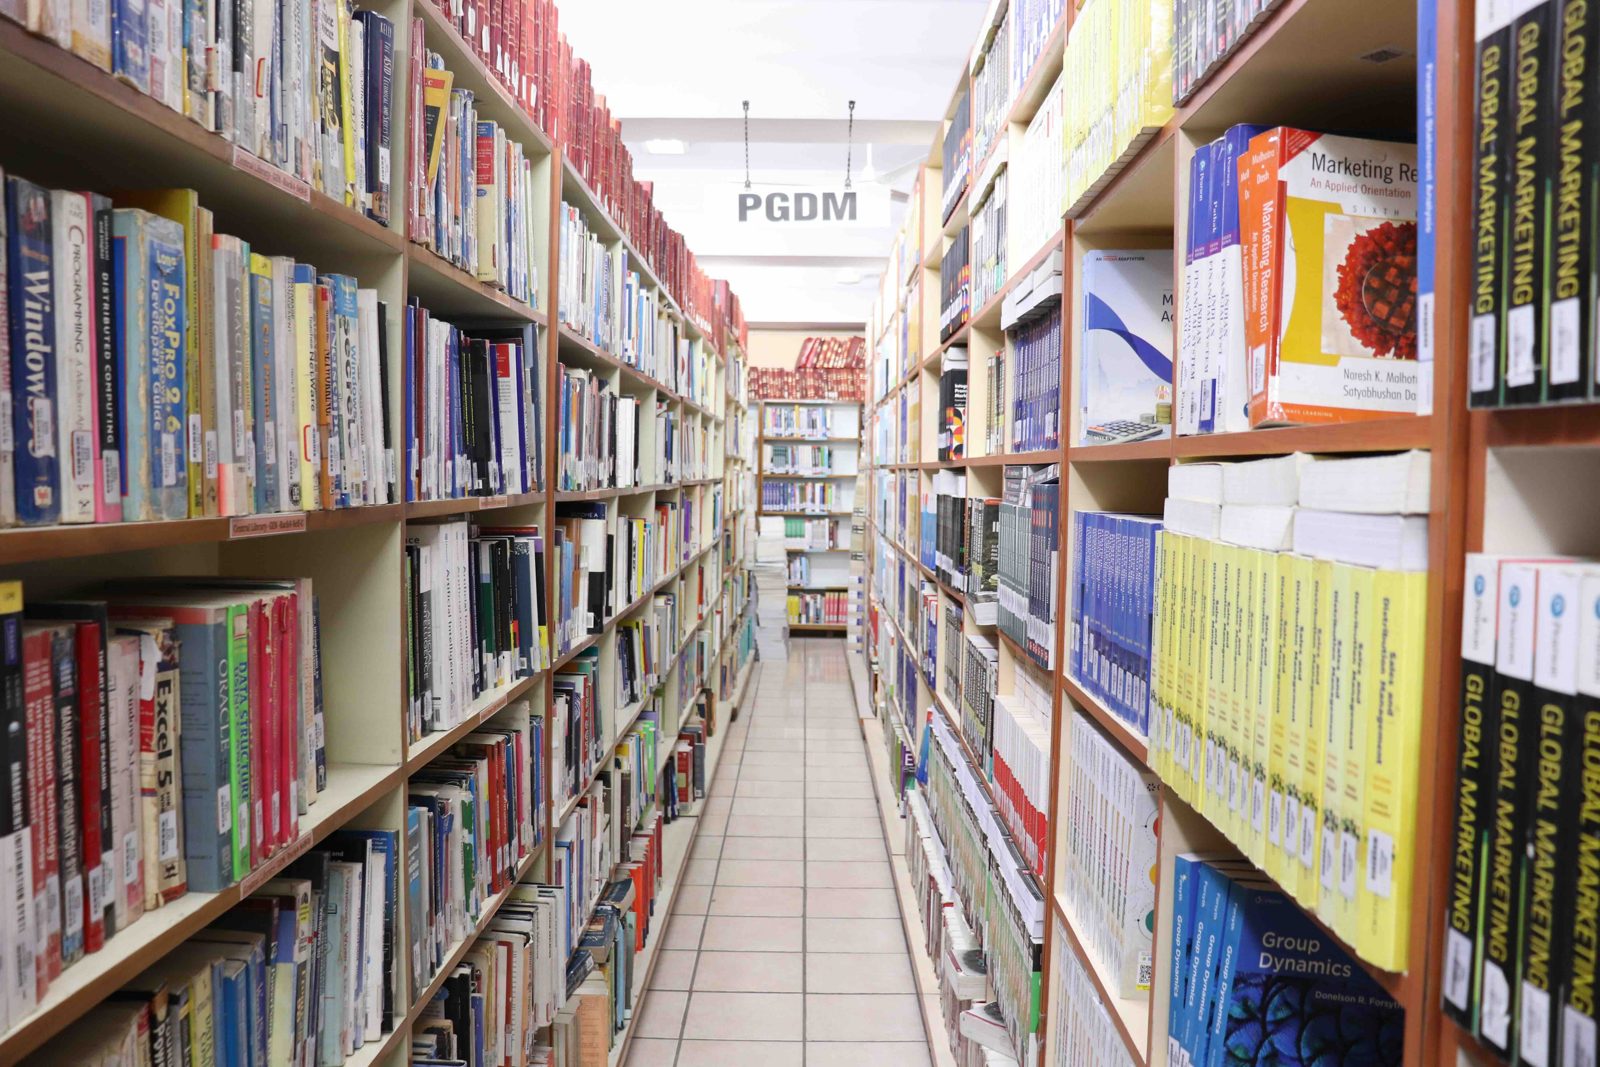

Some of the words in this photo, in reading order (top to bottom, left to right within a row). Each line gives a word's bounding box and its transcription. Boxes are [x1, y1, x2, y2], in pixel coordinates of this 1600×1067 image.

[323, 60, 337, 108] Java
[1425, 63, 1434, 116] Financial
[1515, 22, 1540, 133] GLOBAL
[1561, 0, 1587, 117] GLOBAL
[1480, 45, 1501, 150] GLOBAL
[1312, 152, 1394, 184] Marketing
[1400, 163, 1417, 183] Re
[1425, 119, 1434, 181] Statement
[738, 192, 857, 222] PGDM
[1310, 178, 1322, 189] An
[1325, 180, 1358, 194] Applied
[1361, 184, 1412, 199] Orientation
[1424, 184, 1434, 233] Analysis
[1556, 119, 1583, 299] MARKETING
[1260, 200, 1274, 269] Marketing
[1476, 153, 1498, 314] MARKETING
[1512, 136, 1537, 305] MARKETING
[1251, 243, 1259, 270] Applied
[72, 243, 85, 353] PROGRAMMING
[102, 272, 112, 360] DISTRIBUTED
[1259, 270, 1272, 333] Research
[23, 269, 53, 408] Window
[104, 364, 114, 444] COMPUTING
[152, 382, 163, 432] Guide
[1343, 385, 1401, 400] Satyabhushan
[1405, 389, 1416, 401] Da
[1344, 369, 1372, 382] Naresh
[1375, 371, 1383, 383] K.
[166, 386, 182, 433] 2.6
[1381, 597, 1390, 675] Distribution
[219, 658, 230, 752] ORACLE
[239, 661, 248, 704] DATA
[1387, 692, 1395, 717] and
[44, 694, 56, 779] Information
[61, 705, 73, 782] MANAGEMENT
[99, 706, 107, 740] PUBLIC
[157, 679, 173, 760] Excel
[1377, 680, 1386, 764] Management
[1462, 673, 1484, 770] GLOBAL
[1498, 689, 1520, 795] GLOBAL
[100, 743, 108, 790] SPEAKING
[158, 770, 173, 788] 5
[1536, 703, 1564, 812] GLOBAL
[1581, 711, 1600, 826] GLOBAL
[45, 784, 58, 861] Technology
[63, 783, 76, 854] INFORMATION
[1452, 776, 1478, 932] MARKETING
[1489, 799, 1514, 962] MARKETING
[1174, 915, 1184, 946] Group
[1527, 817, 1557, 991] MARKETING
[1570, 831, 1600, 1016] MARKETING
[1194, 922, 1205, 954] Group
[1205, 934, 1216, 968] Group
[1222, 945, 1234, 979] Group
[1258, 952, 1352, 978] Dynamics
[1262, 931, 1320, 954] Group
[1173, 948, 1183, 998] Dynamics
[1188, 956, 1201, 1006] Dynamics
[1198, 970, 1211, 1022] Dynamics
[1315, 990, 1356, 1003] Donelson
[1215, 982, 1228, 1035] Dynamics
